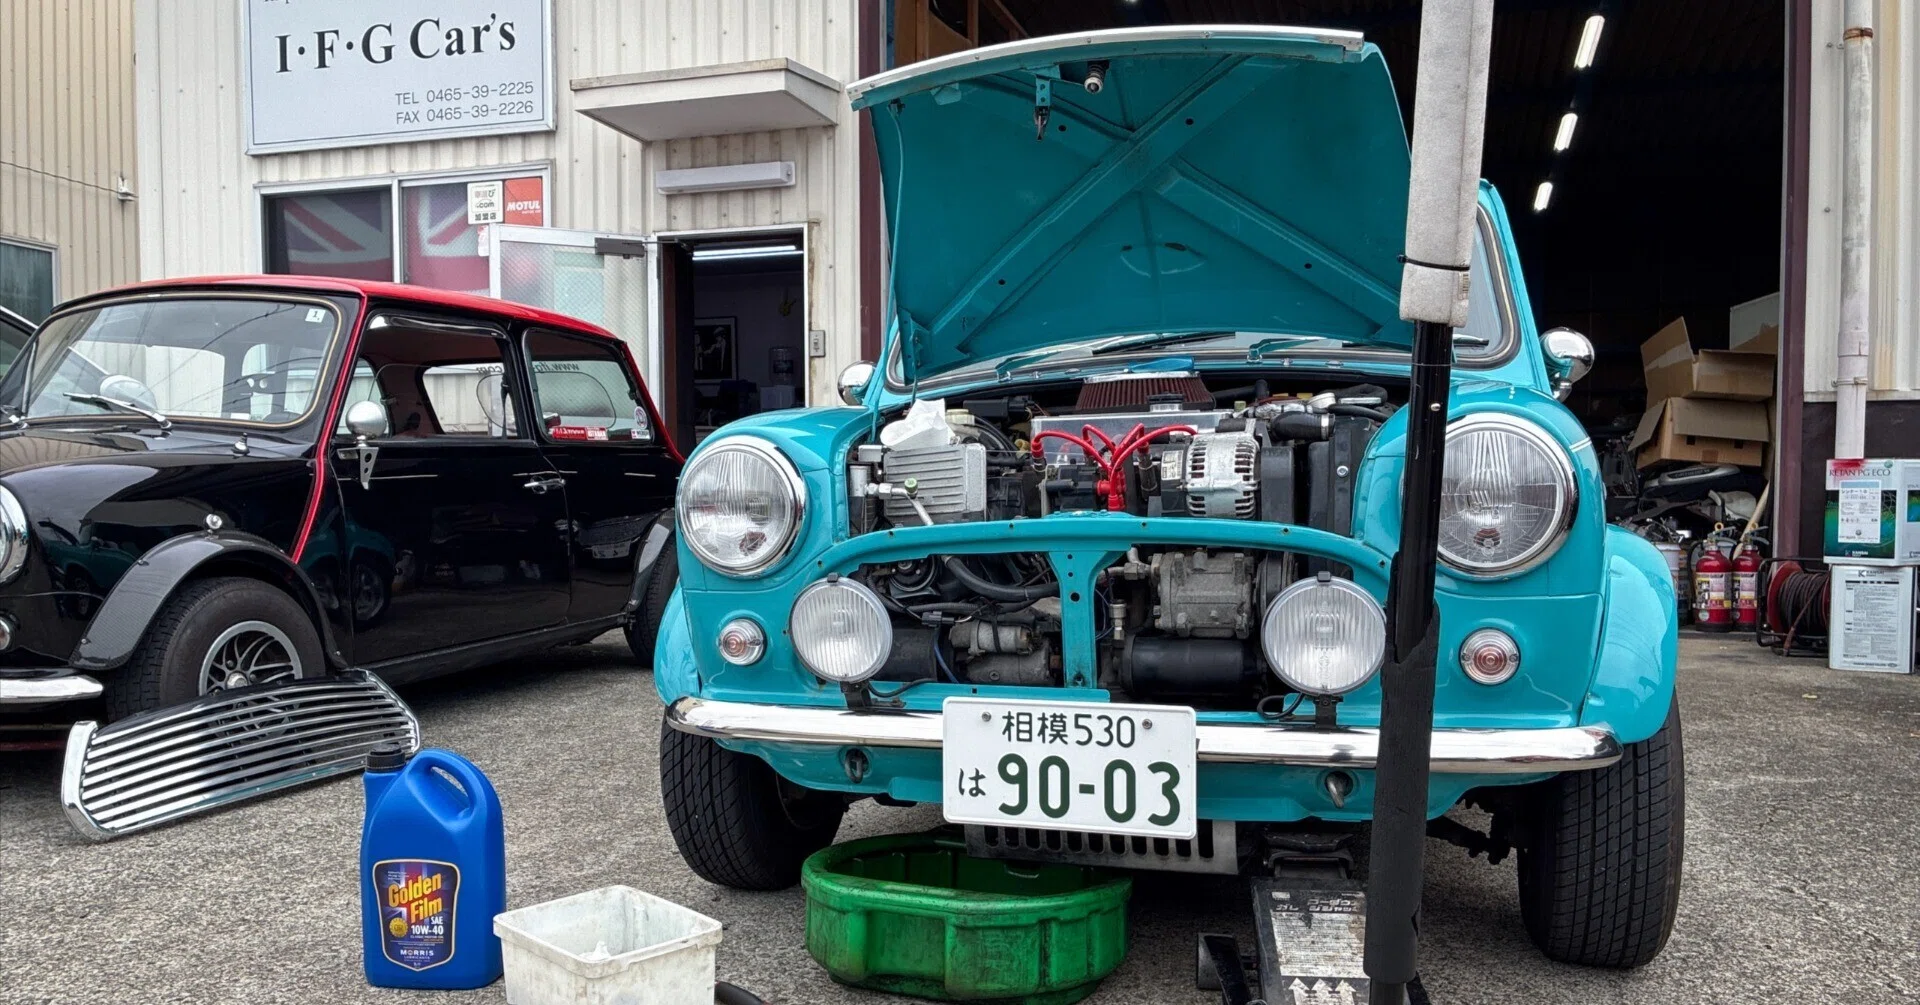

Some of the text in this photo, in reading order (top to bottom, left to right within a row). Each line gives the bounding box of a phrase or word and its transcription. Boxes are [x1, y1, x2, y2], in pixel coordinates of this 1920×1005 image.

[395, 81, 534, 105] TEL 0465-39-2225
[396, 101, 534, 124] FAX 0465-39-2226
[506, 200, 541, 211] MOTUL
[1872, 469, 1891, 477] ECO
[958, 753, 1180, 827] は 90-03
[388, 873, 442, 908] Golden
[410, 897, 442, 924] Film
[430, 916, 444, 925] SAE
[411, 925, 444, 935] 10W-40
[400, 949, 435, 957] MORRIS
